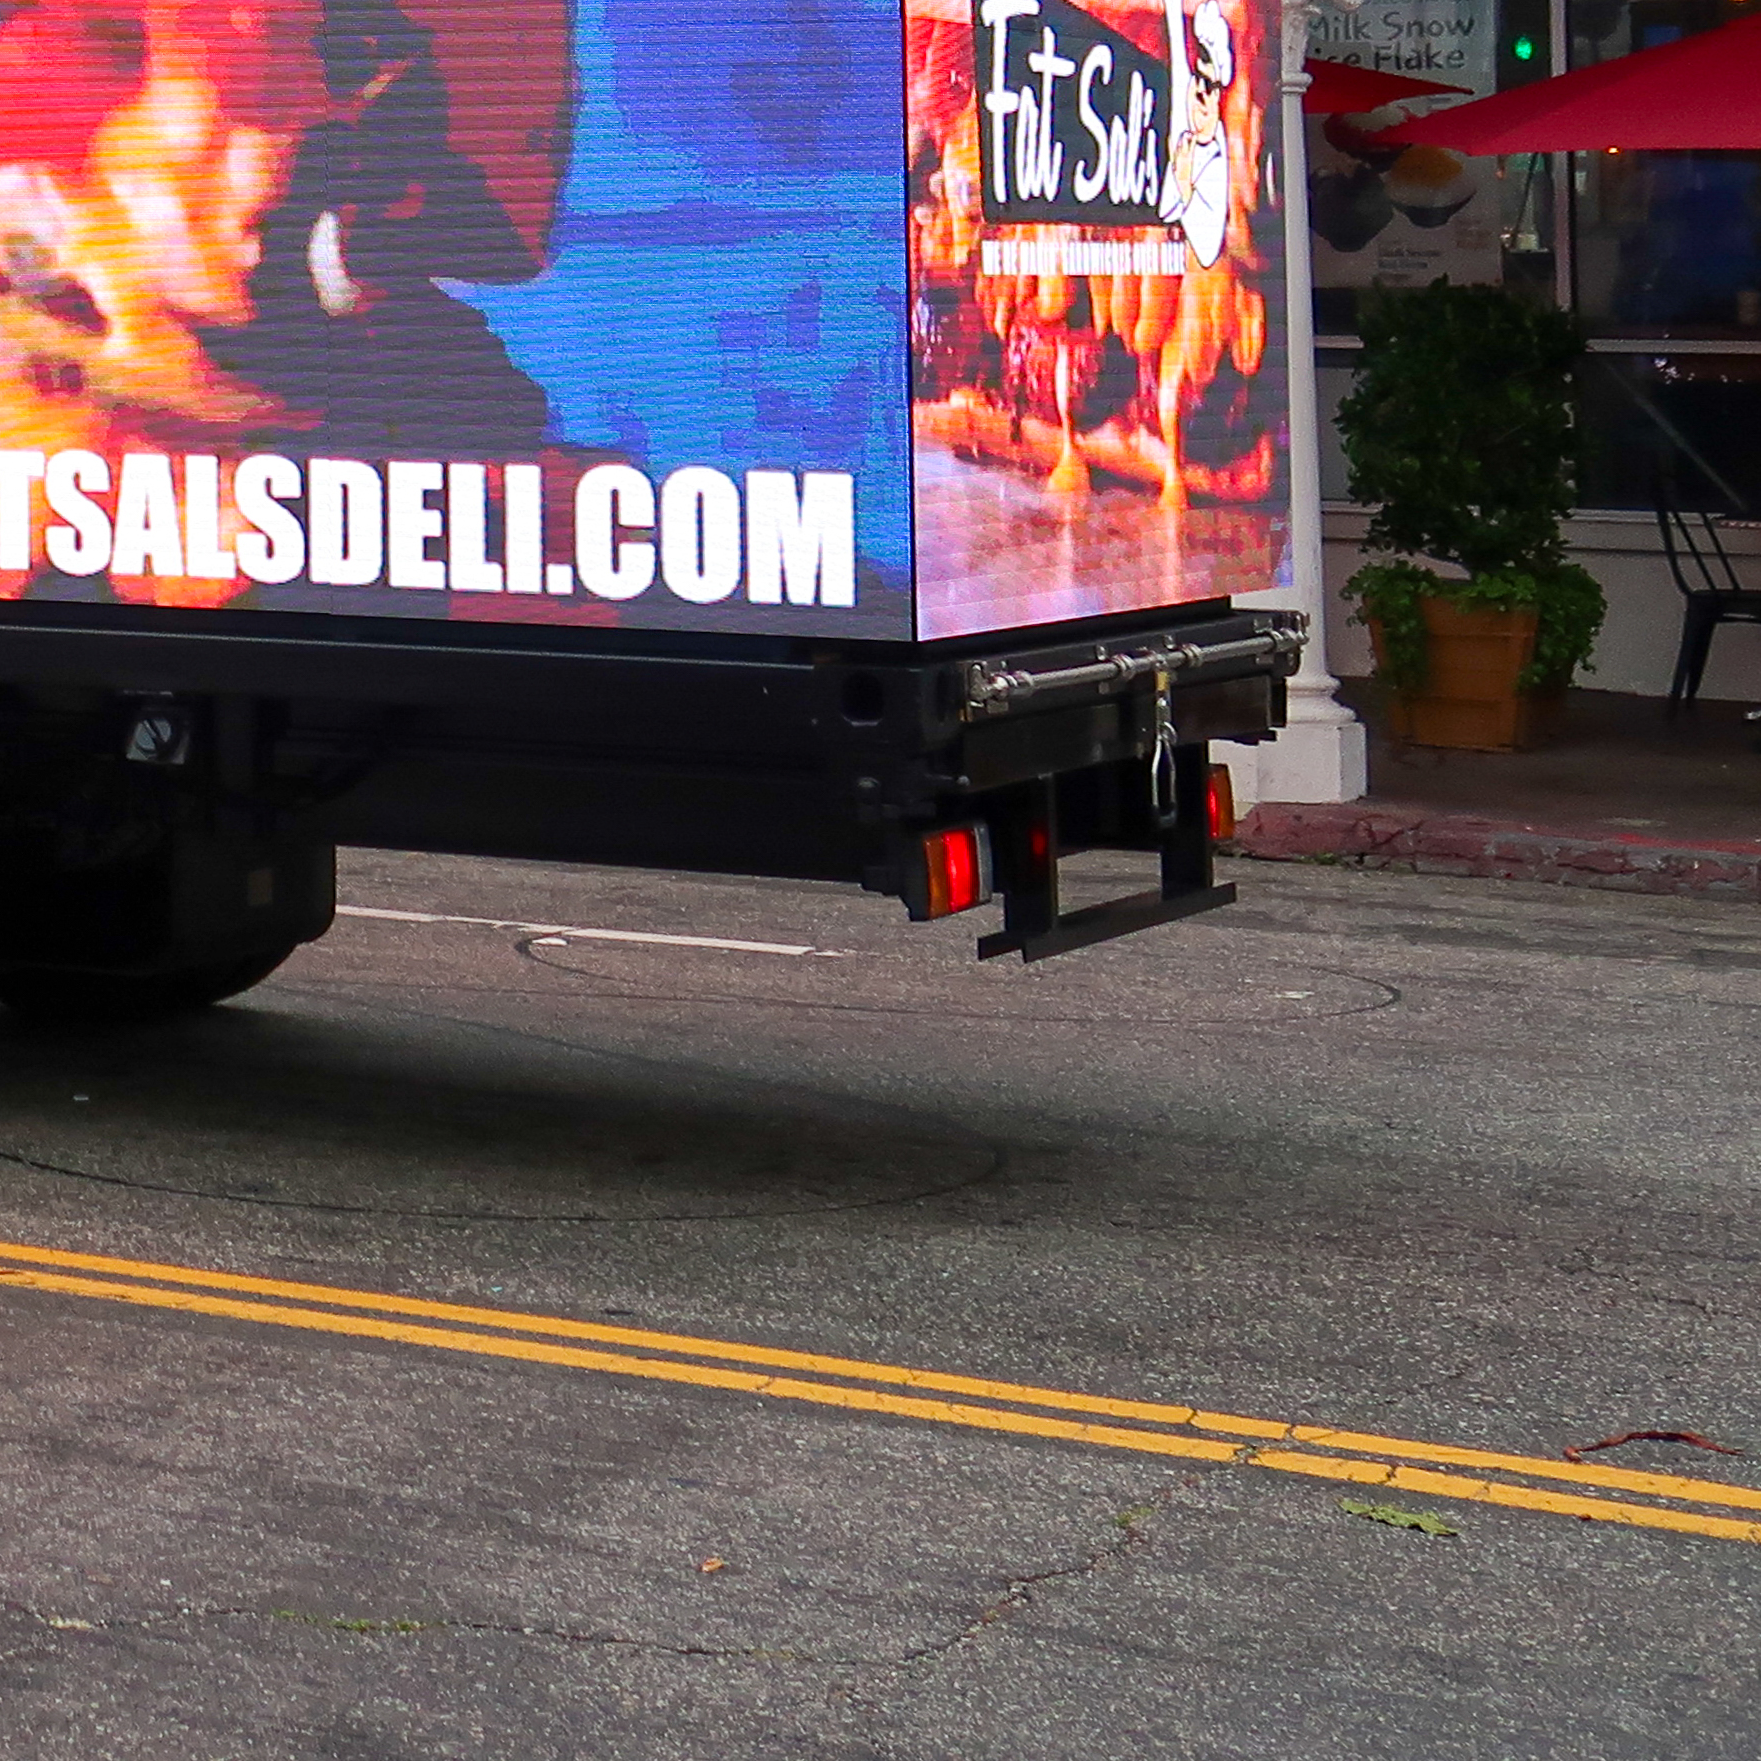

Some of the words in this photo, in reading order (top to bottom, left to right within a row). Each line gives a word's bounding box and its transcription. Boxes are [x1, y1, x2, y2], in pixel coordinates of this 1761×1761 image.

[1383, 11, 1475, 42] Snow
[1373, 42, 1466, 71] Flake
[1076, 43, 1160, 206] Sal's
